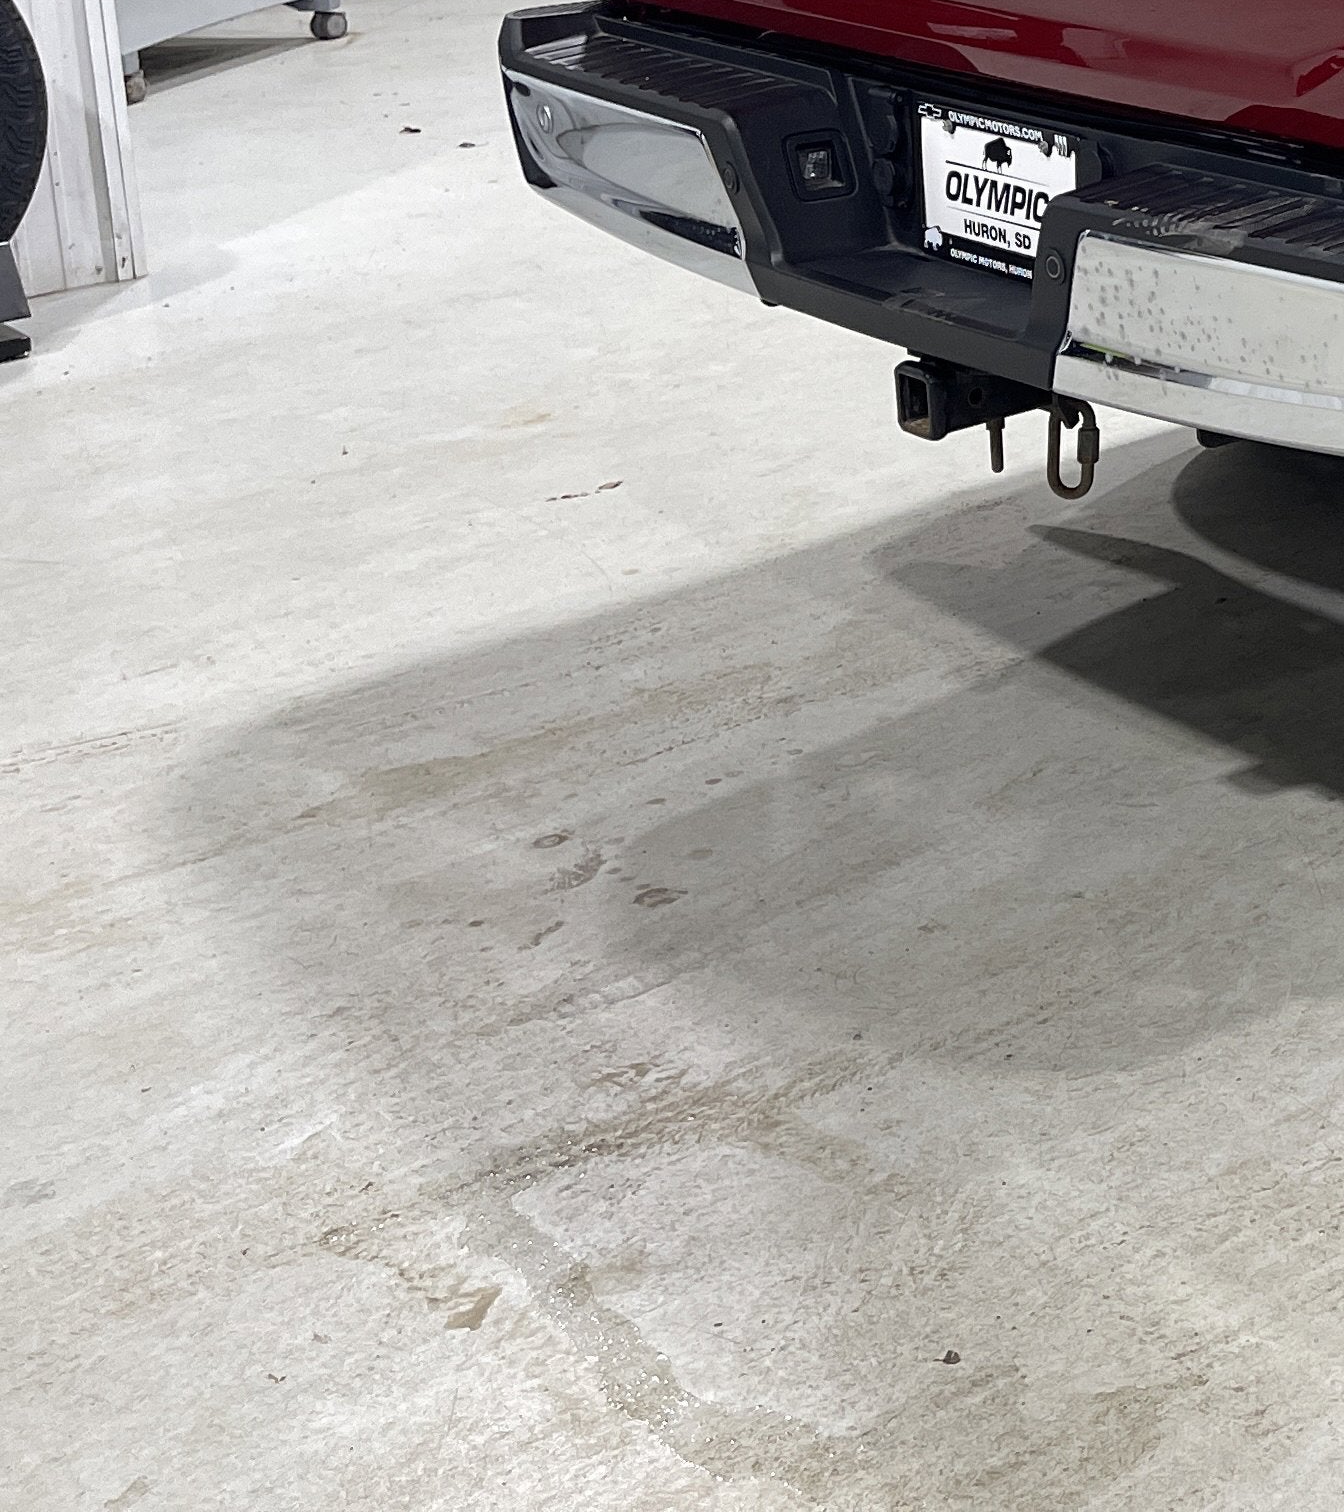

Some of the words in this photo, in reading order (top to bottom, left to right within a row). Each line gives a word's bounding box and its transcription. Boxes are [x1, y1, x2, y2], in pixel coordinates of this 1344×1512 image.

[945, 171, 1050, 223] OLYMPIC
[964, 219, 1010, 248] HURON,
[1014, 232, 1031, 250] SD
[950, 248, 977, 264] OLYMPIC
